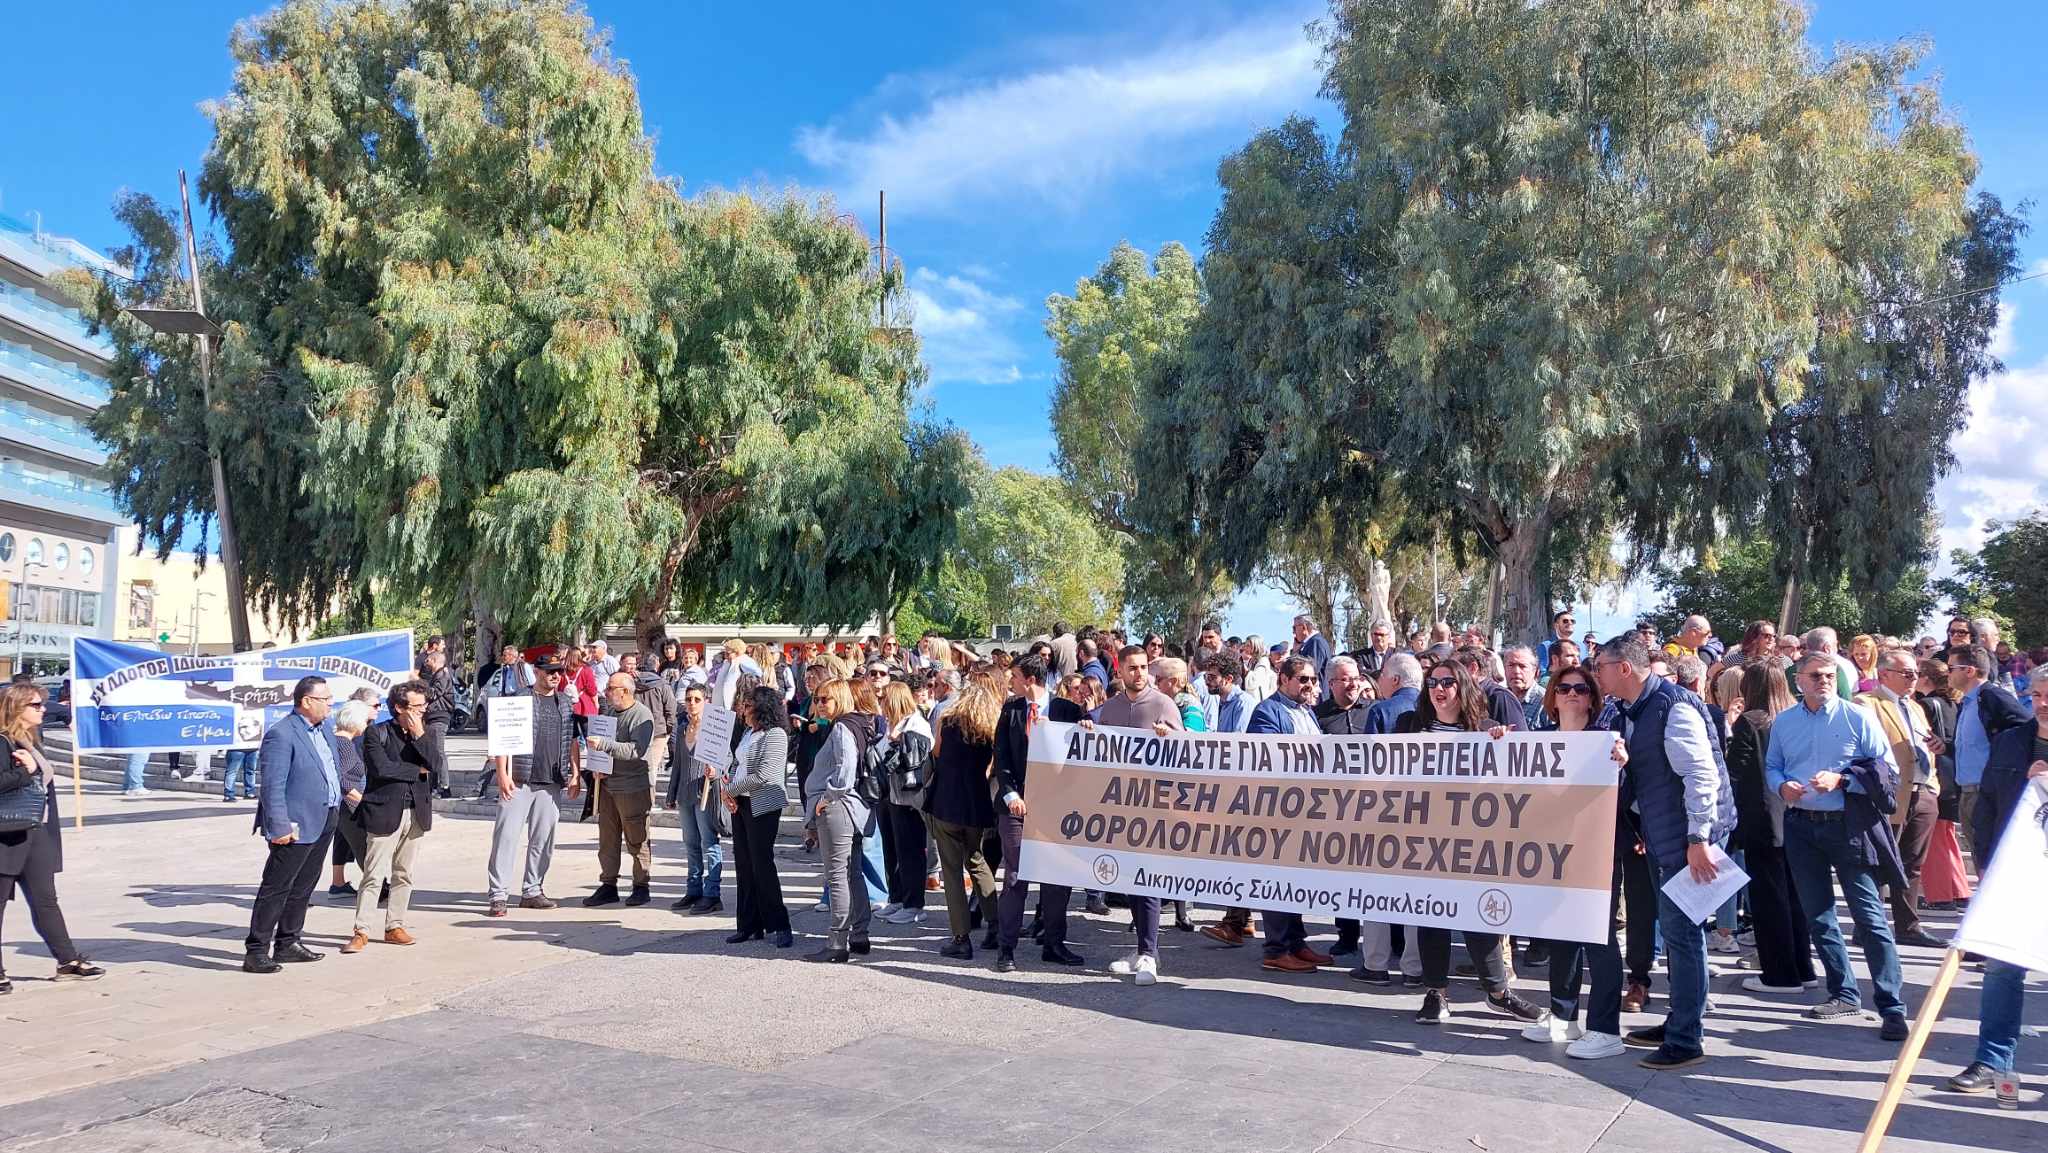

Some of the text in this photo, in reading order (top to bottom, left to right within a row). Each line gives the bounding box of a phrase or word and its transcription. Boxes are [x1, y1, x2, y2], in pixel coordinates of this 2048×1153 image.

[90, 660, 167, 706] ΣΥΛΛΟΓΟΣ
[1067, 731, 1566, 778] ΑΓΩΝΙΖΟΜΑΣΤΕ ΓΙΑ ΤΗΝ ΑΞΙΟΠΡΕΠΕΙΑ ΜΑΣ
[1100, 776, 1532, 829] ΑΜΕΣΗ ΑΠΟΣΥΡΣΗ ΤΟΥ
[1060, 811, 1574, 880] ΦΟΡΟΛΟΓΙΚΟΥ ΝΟΜΟΣΧΕΔΙΟΥ
[1134, 867, 1458, 918] Δικηγορικός Σύλλογος Ηρακλείου
